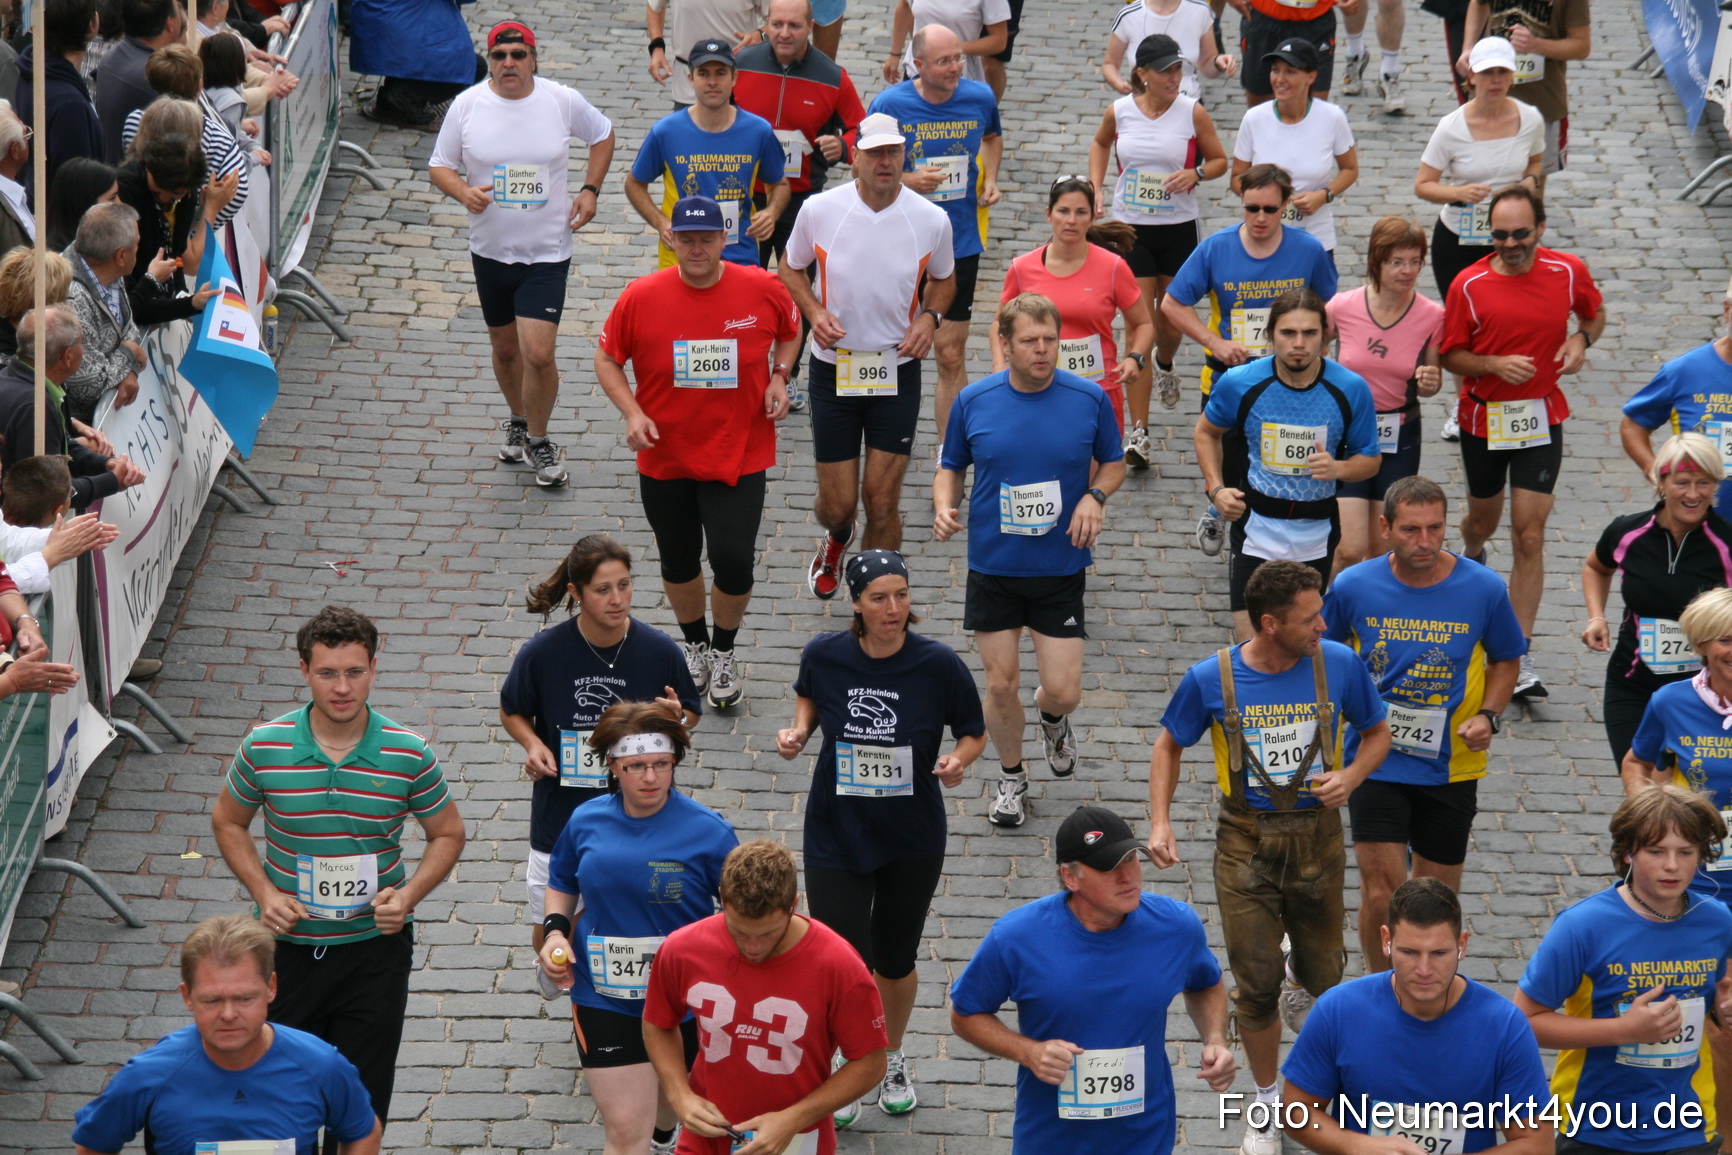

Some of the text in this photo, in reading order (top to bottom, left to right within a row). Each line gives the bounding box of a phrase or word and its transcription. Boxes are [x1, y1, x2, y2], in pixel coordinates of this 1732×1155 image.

[902, 120, 978, 132] 10. NEUMARKTER
[915, 130, 968, 140] STADTLAUF
[675, 155, 752, 164] 10. NEUMARKTER
[688, 163, 740, 172] STADTLAUF
[509, 169, 536, 179] Günther
[1140, 175, 1162, 184] Sabine
[510, 182, 543, 194] 2796
[1139, 187, 1171, 201] 2638
[685, 209, 706, 217] S-KG
[1223, 277, 1305, 291] 10. NEUMARKTER
[1247, 313, 1264, 322] Miro
[691, 344, 730, 354] Karl-Heinz
[1061, 343, 1089, 353] Melissa
[692, 358, 730, 372] 2608
[1068, 354, 1095, 370] 819
[858, 366, 888, 380] 996
[1693, 394, 1707, 403] 10.
[1503, 405, 1525, 414] Elmar
[1511, 416, 1538, 433] 630
[1280, 428, 1315, 440] Benedikt
[1013, 490, 1043, 500] Thomas
[1016, 502, 1055, 518] 3702
[1365, 617, 1469, 634] 10. NEUMARKTER
[1378, 628, 1451, 644] STADTLAUF
[574, 676, 627, 687] KFZ-Heinloth
[1401, 678, 1451, 690] 20.09.2009
[848, 688, 899, 700] KFZ-Heinloth
[573, 713, 593, 721] Auto
[1391, 709, 1416, 722] Peter
[844, 722, 895, 735] Auto Kukula
[1390, 724, 1434, 743] 2742
[1264, 729, 1297, 744] Roland
[1679, 736, 1695, 746] 10.
[857, 749, 891, 760] Kerstin
[859, 763, 902, 779] 3131
[320, 861, 354, 872] Marcus
[318, 880, 368, 897] 6122
[609, 943, 634, 954] Karin
[1607, 958, 1717, 975] 10. NEUMARKTER
[1627, 974, 1708, 989] STADTLAUF
[735, 1024, 762, 1036] RIU
[1083, 1074, 1135, 1095] 3798
[1113, 1102, 1143, 1113] PFLEIDERER
